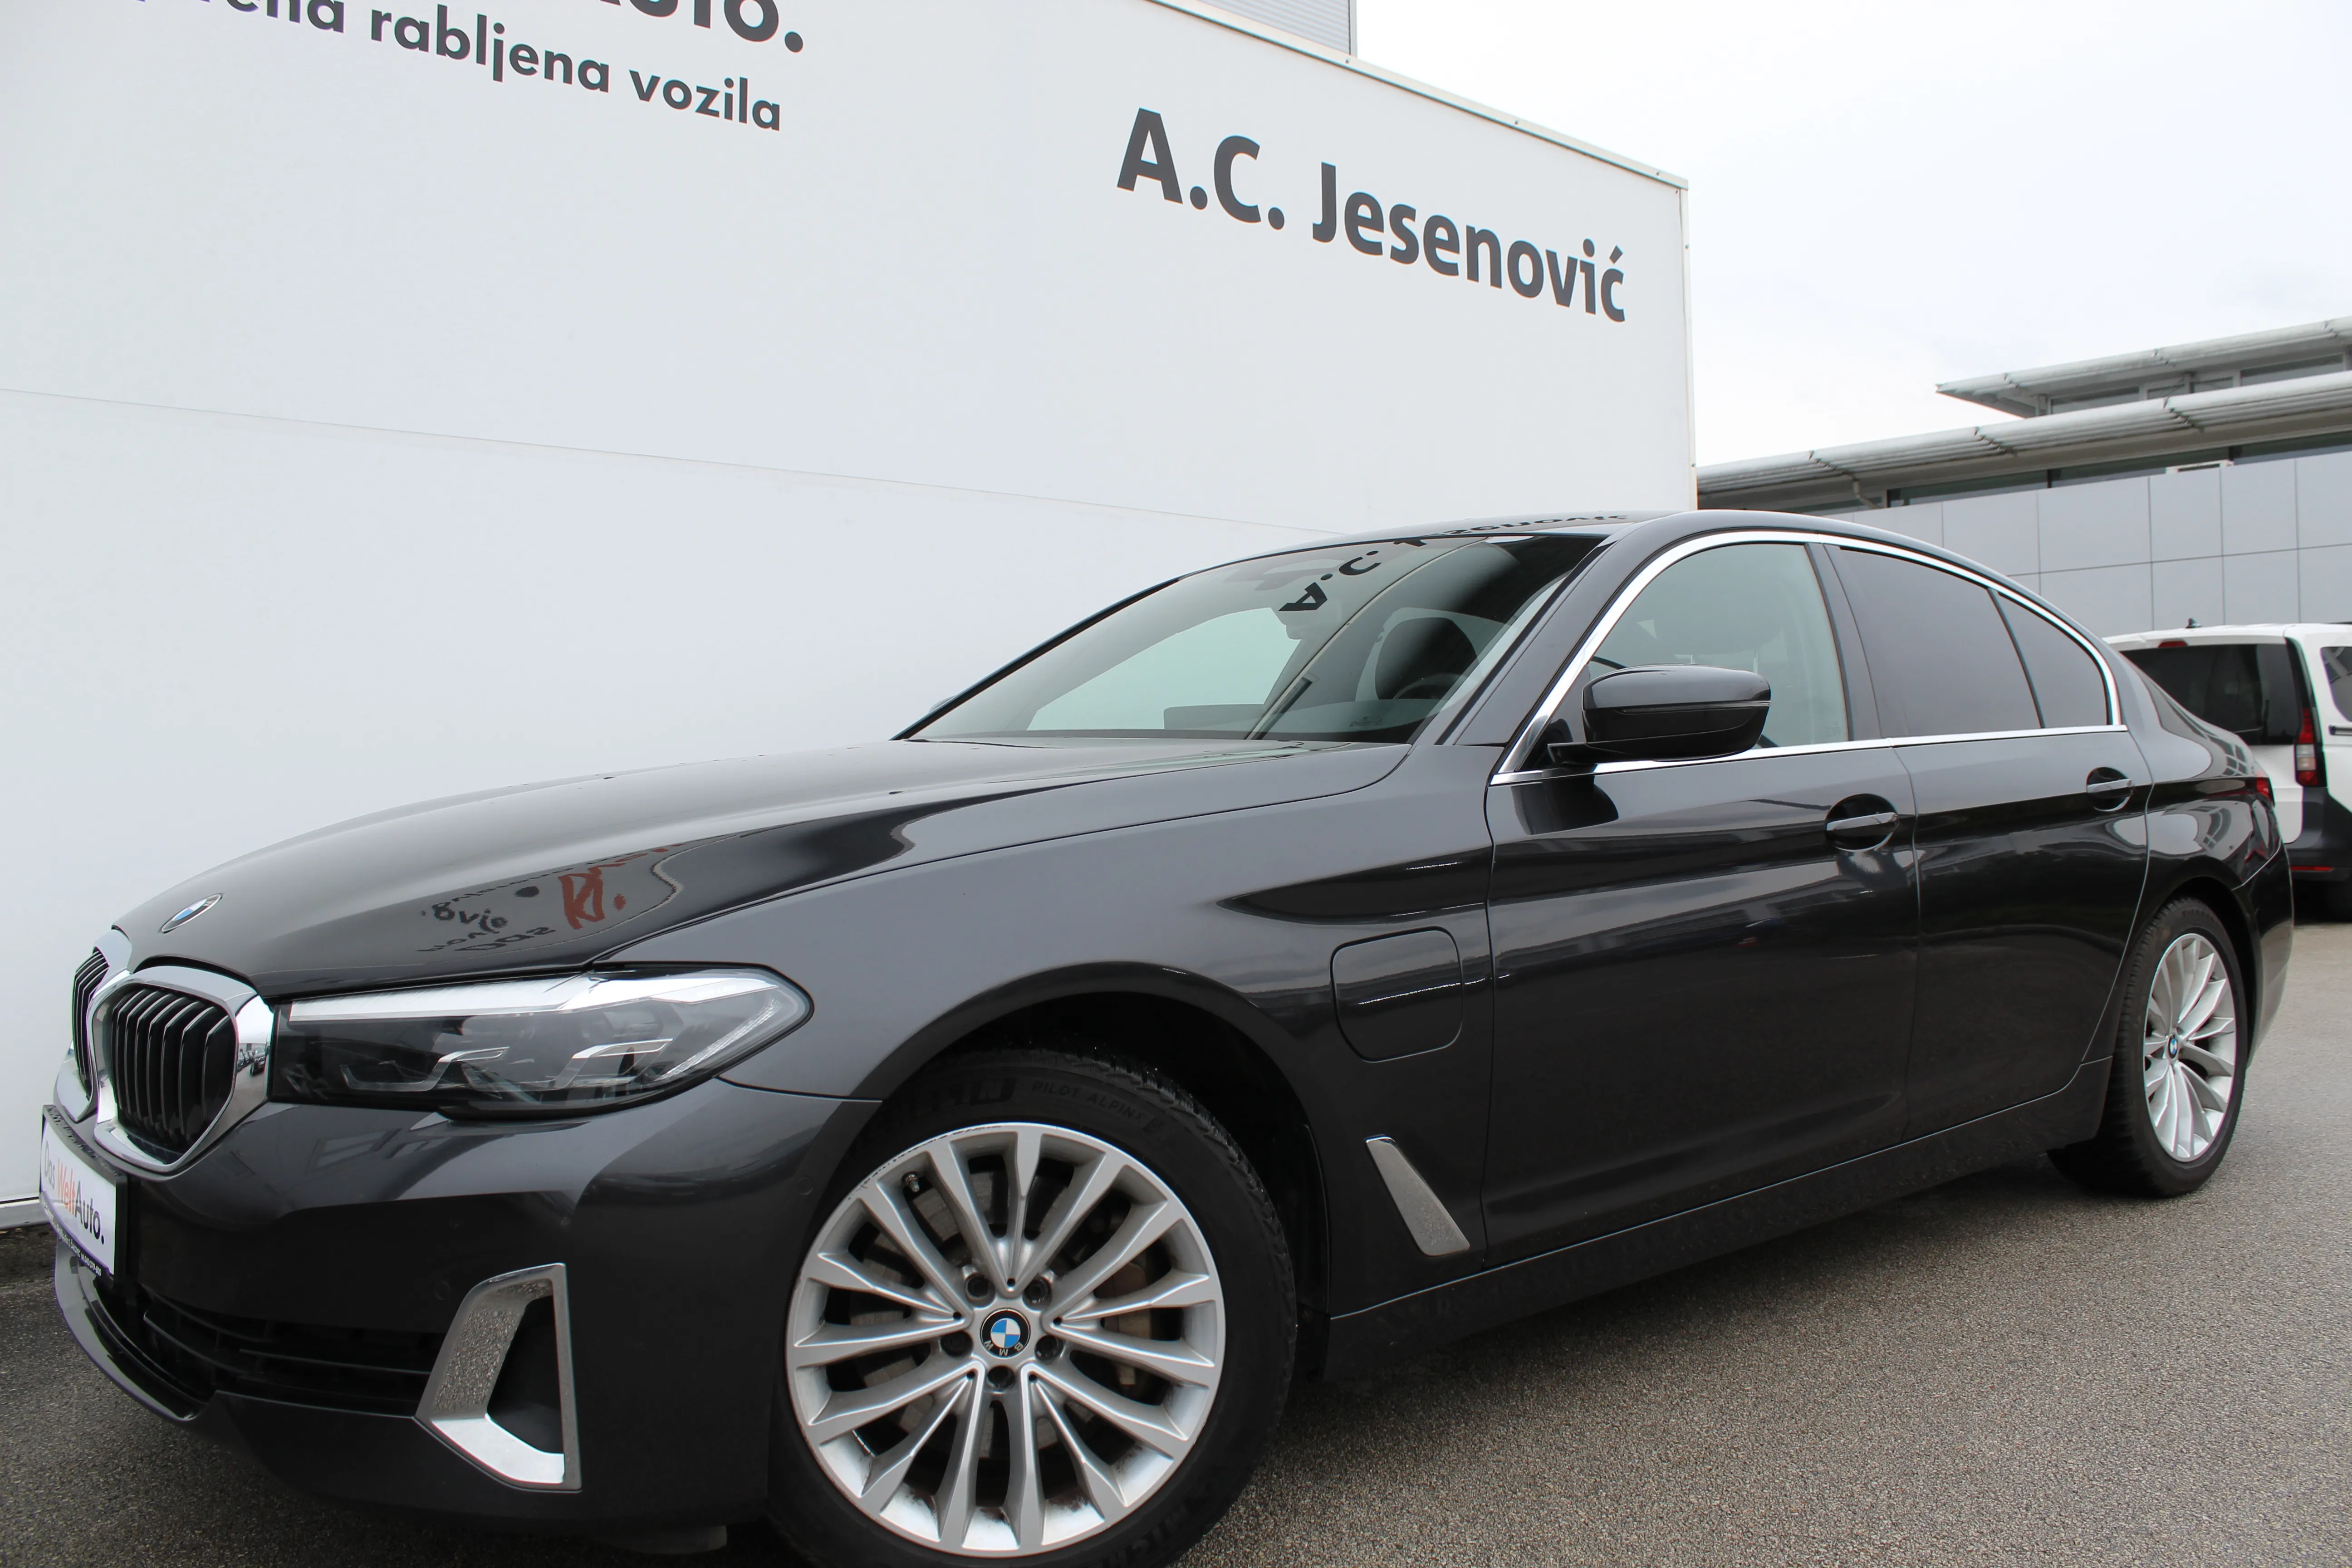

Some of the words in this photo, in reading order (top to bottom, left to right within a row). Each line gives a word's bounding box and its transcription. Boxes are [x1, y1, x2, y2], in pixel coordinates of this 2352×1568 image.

[371, 4, 609, 93] rabljena
[629, 70, 780, 131] vozila
[1117, 108, 1285, 230] A.C.
[1313, 162, 1625, 322] Jesenović
[44, 1140, 55, 1190] Das
[58, 1157, 105, 1245] WeltAuto.
[984, 1340, 1024, 1357] BMW
